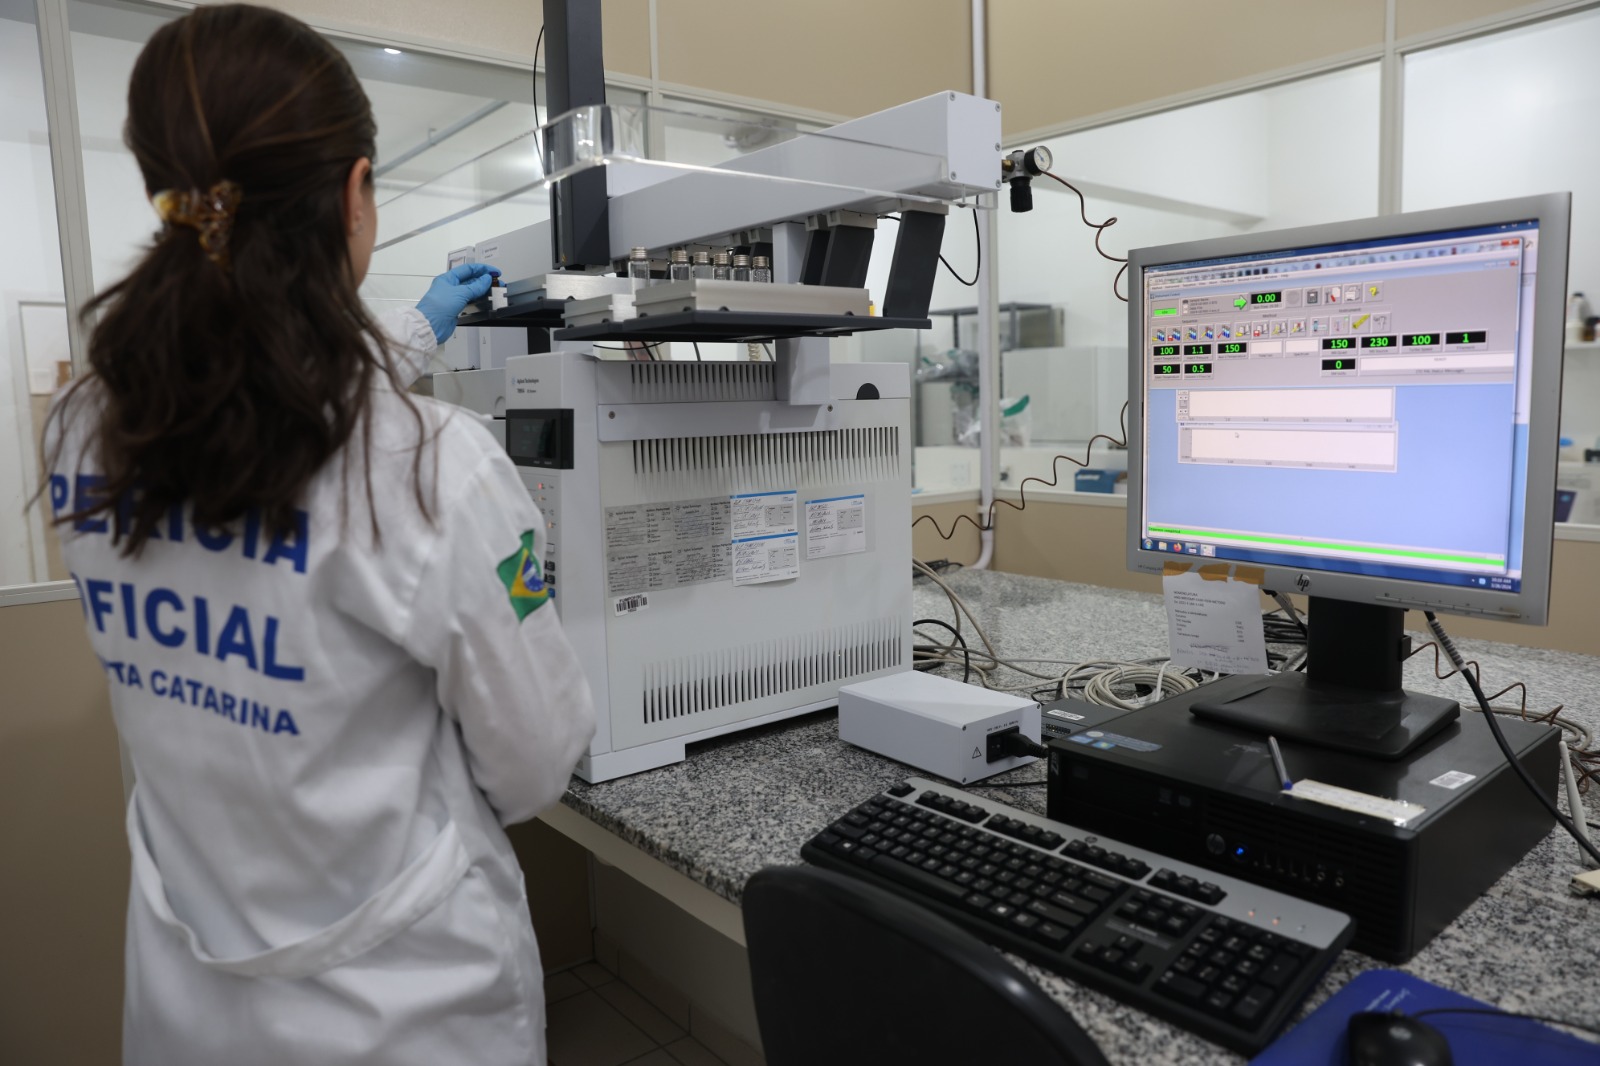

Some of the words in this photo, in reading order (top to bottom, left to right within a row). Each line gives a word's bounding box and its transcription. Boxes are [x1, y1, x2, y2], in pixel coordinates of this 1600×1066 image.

[1257, 294, 1276, 303] 0.00
[1370, 337, 1388, 347] 230
[1412, 335, 1431, 345] 100
[1462, 333, 1469, 343] 1
[1225, 344, 1240, 352] 150
[1331, 339, 1348, 349] 150
[1192, 346, 1203, 354] 1.1
[1336, 360, 1342, 369] 0
[1296, 574, 1310, 592] hp
[69, 572, 306, 682] FICIAL
[149, 669, 300, 736] CATARINA
